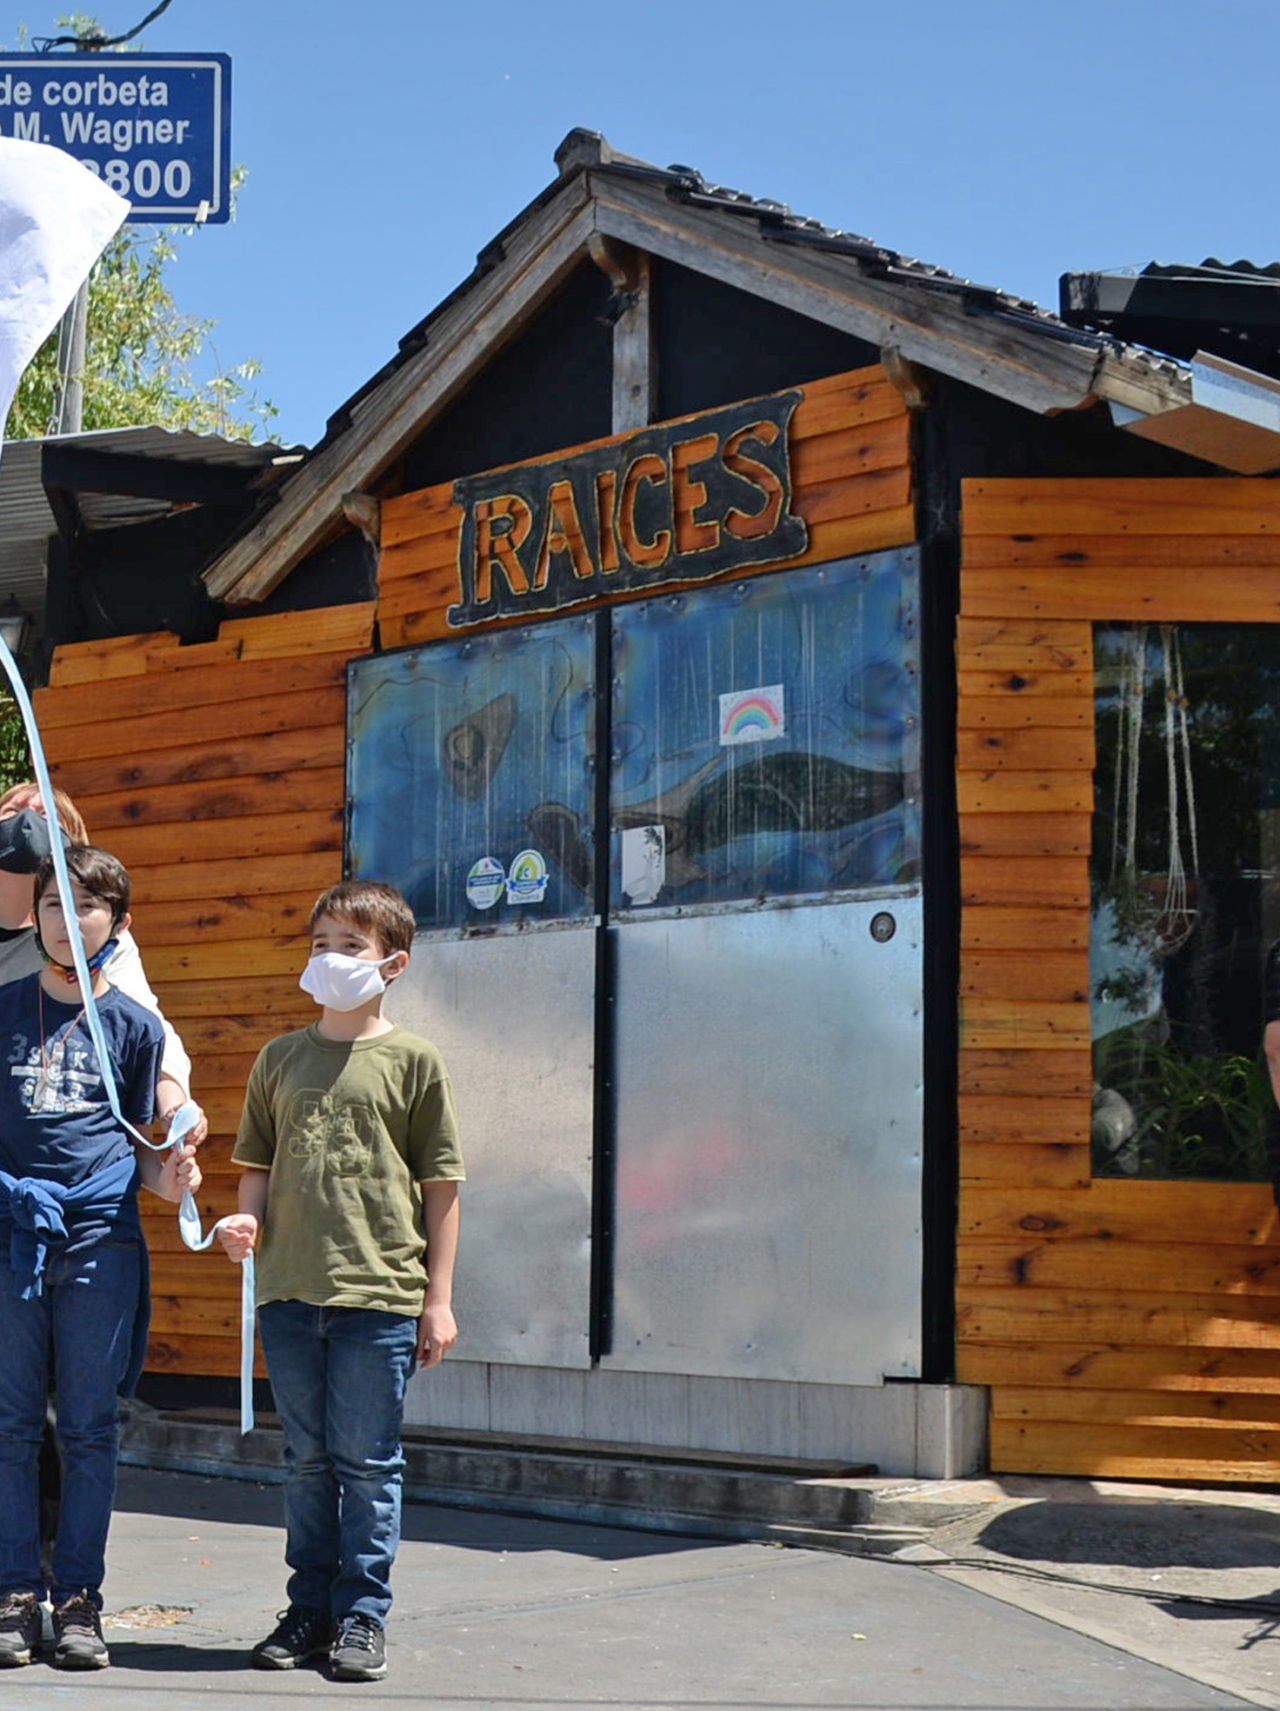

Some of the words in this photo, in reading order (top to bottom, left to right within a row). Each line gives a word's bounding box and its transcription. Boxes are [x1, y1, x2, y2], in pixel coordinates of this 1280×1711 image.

[42, 73, 169, 106] corbeta
[13, 111, 51, 142] M.
[61, 111, 190, 152] Wagner
[473, 420, 783, 605] RAICES
